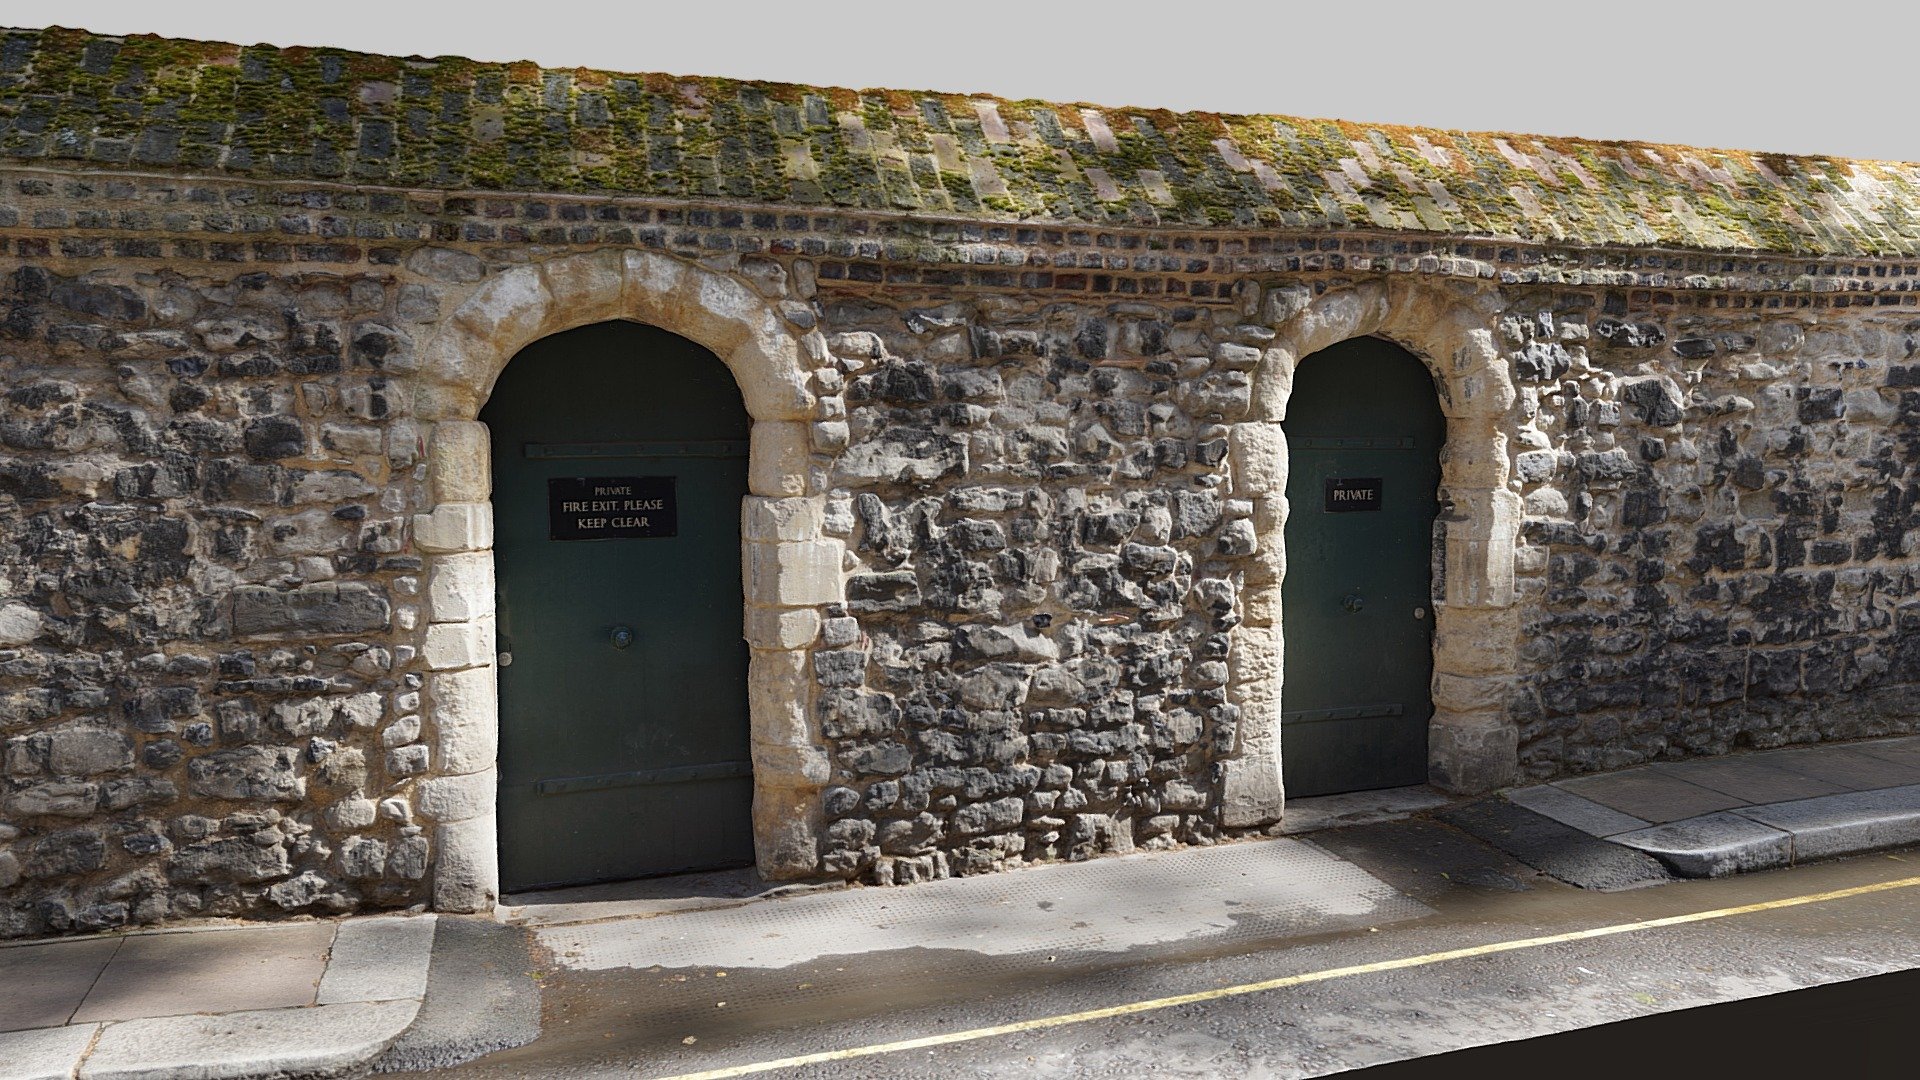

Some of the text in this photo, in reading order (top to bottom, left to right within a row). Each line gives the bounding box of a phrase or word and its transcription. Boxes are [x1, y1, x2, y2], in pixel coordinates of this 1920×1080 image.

[595, 487, 632, 496] PRIVATE
[1333, 489, 1374, 501] PRIVATE
[563, 502, 588, 512] FIRE
[624, 500, 663, 510] PLEASE
[578, 517, 650, 529] KEEP CLEAR
